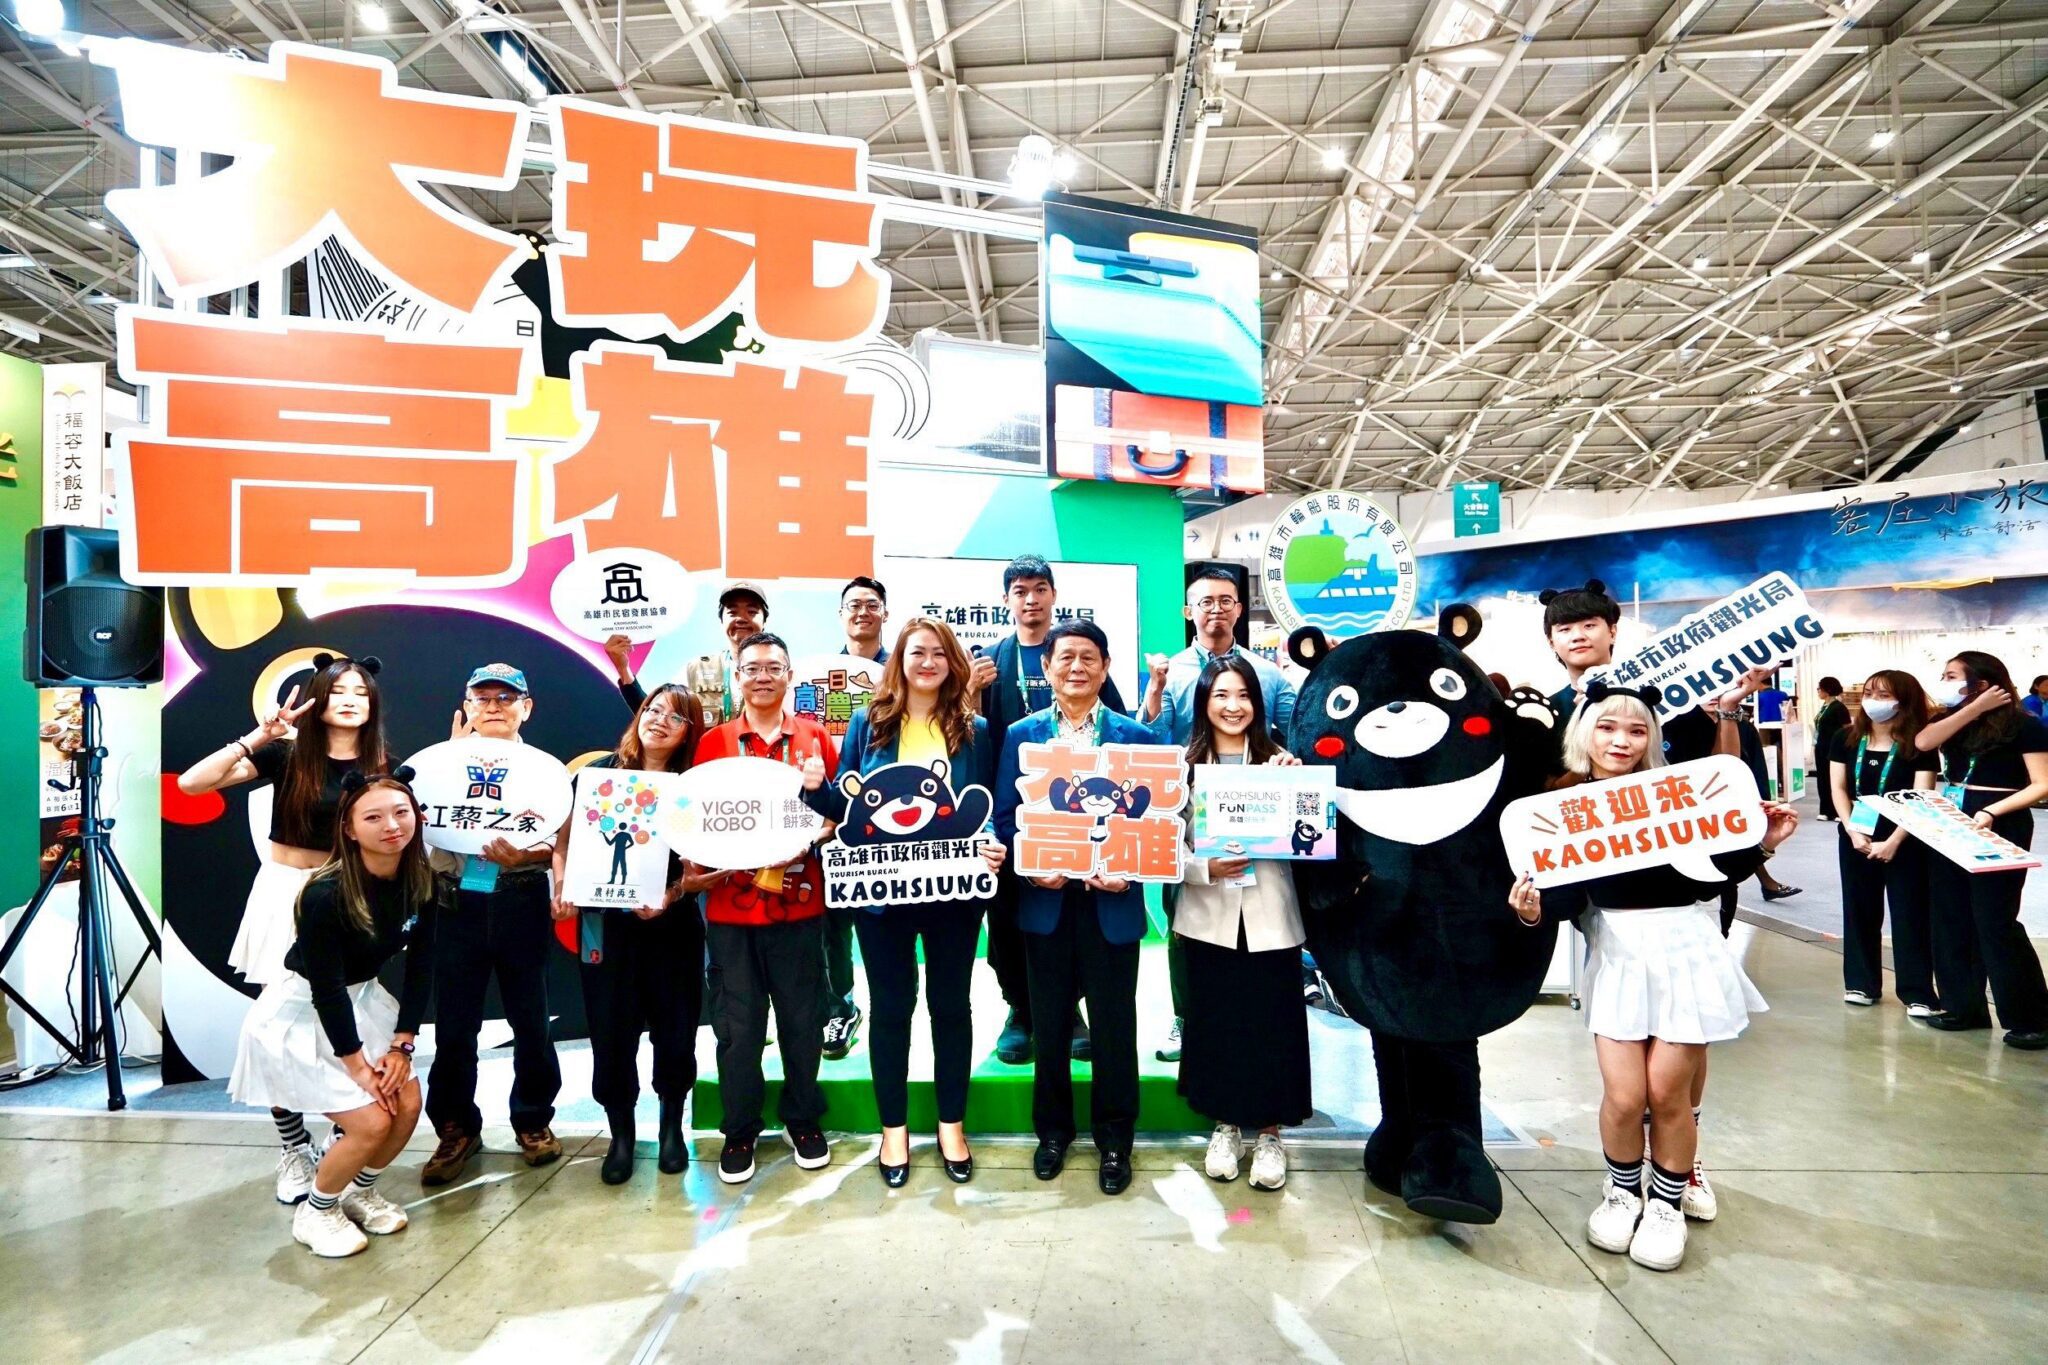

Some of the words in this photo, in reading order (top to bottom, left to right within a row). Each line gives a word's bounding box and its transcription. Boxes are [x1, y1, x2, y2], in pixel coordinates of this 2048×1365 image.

[112, 50, 880, 343] 大玩
[128, 315, 876, 580] 高雄
[64, 412, 84, 511] 福容大飯店
[922, 603, 1094, 626] 高雄市政光局
[964, 631, 999, 639] BUREAU
[1647, 662, 1687, 687] BUREAU
[1023, 745, 1183, 808] 大玩
[702, 799, 762, 816] VIGOR
[1214, 791, 1281, 801] KAOHSIUNG
[1558, 774, 1698, 835] 歡迎來
[702, 816, 756, 832] KOBO
[783, 814, 814, 828] 餅家
[1021, 814, 1180, 876] 高雄
[1532, 809, 1748, 873] KAOHSIUNG
[830, 870, 865, 878] TOURISM
[867, 868, 899, 876] BUREAU
[594, 886, 637, 899] 農村再生
[830, 873, 992, 903] KAOHSIUNG
